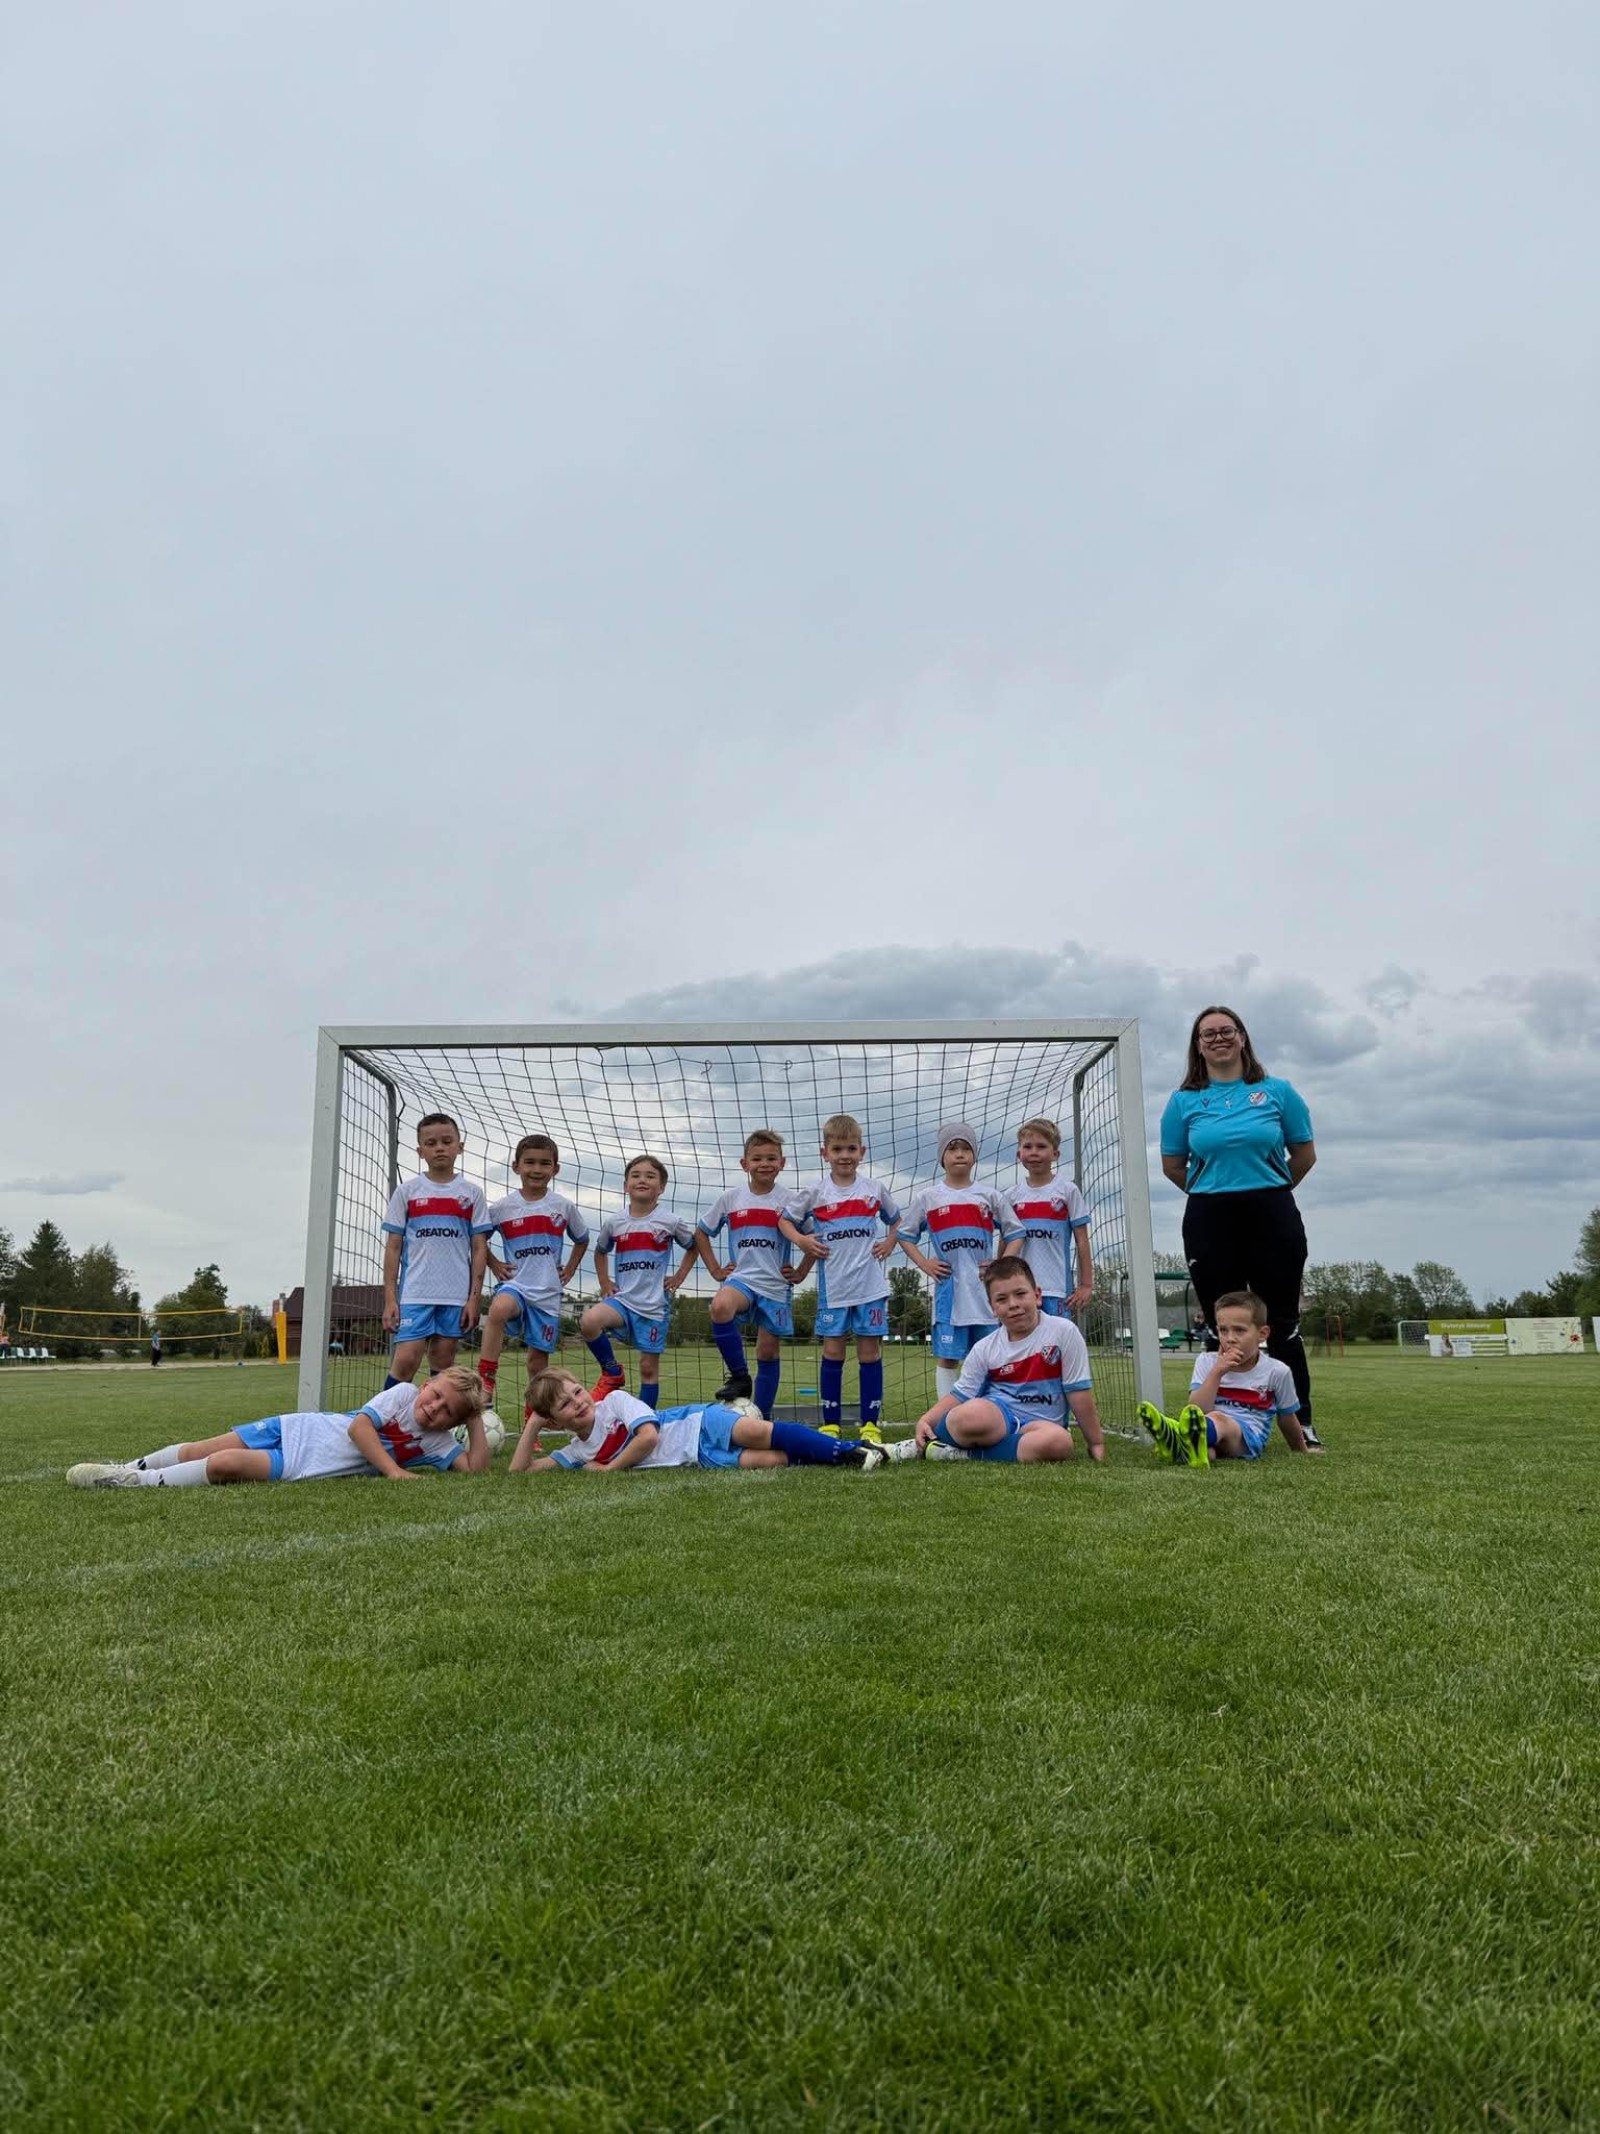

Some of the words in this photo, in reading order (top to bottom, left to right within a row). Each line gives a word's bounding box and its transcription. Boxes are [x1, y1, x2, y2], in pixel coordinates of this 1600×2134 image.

[416, 1228, 459, 1238] CREATON
[827, 1228, 870, 1241] CREATON
[1025, 1229, 1052, 1240] ATON
[941, 1238, 984, 1252] CREATON
